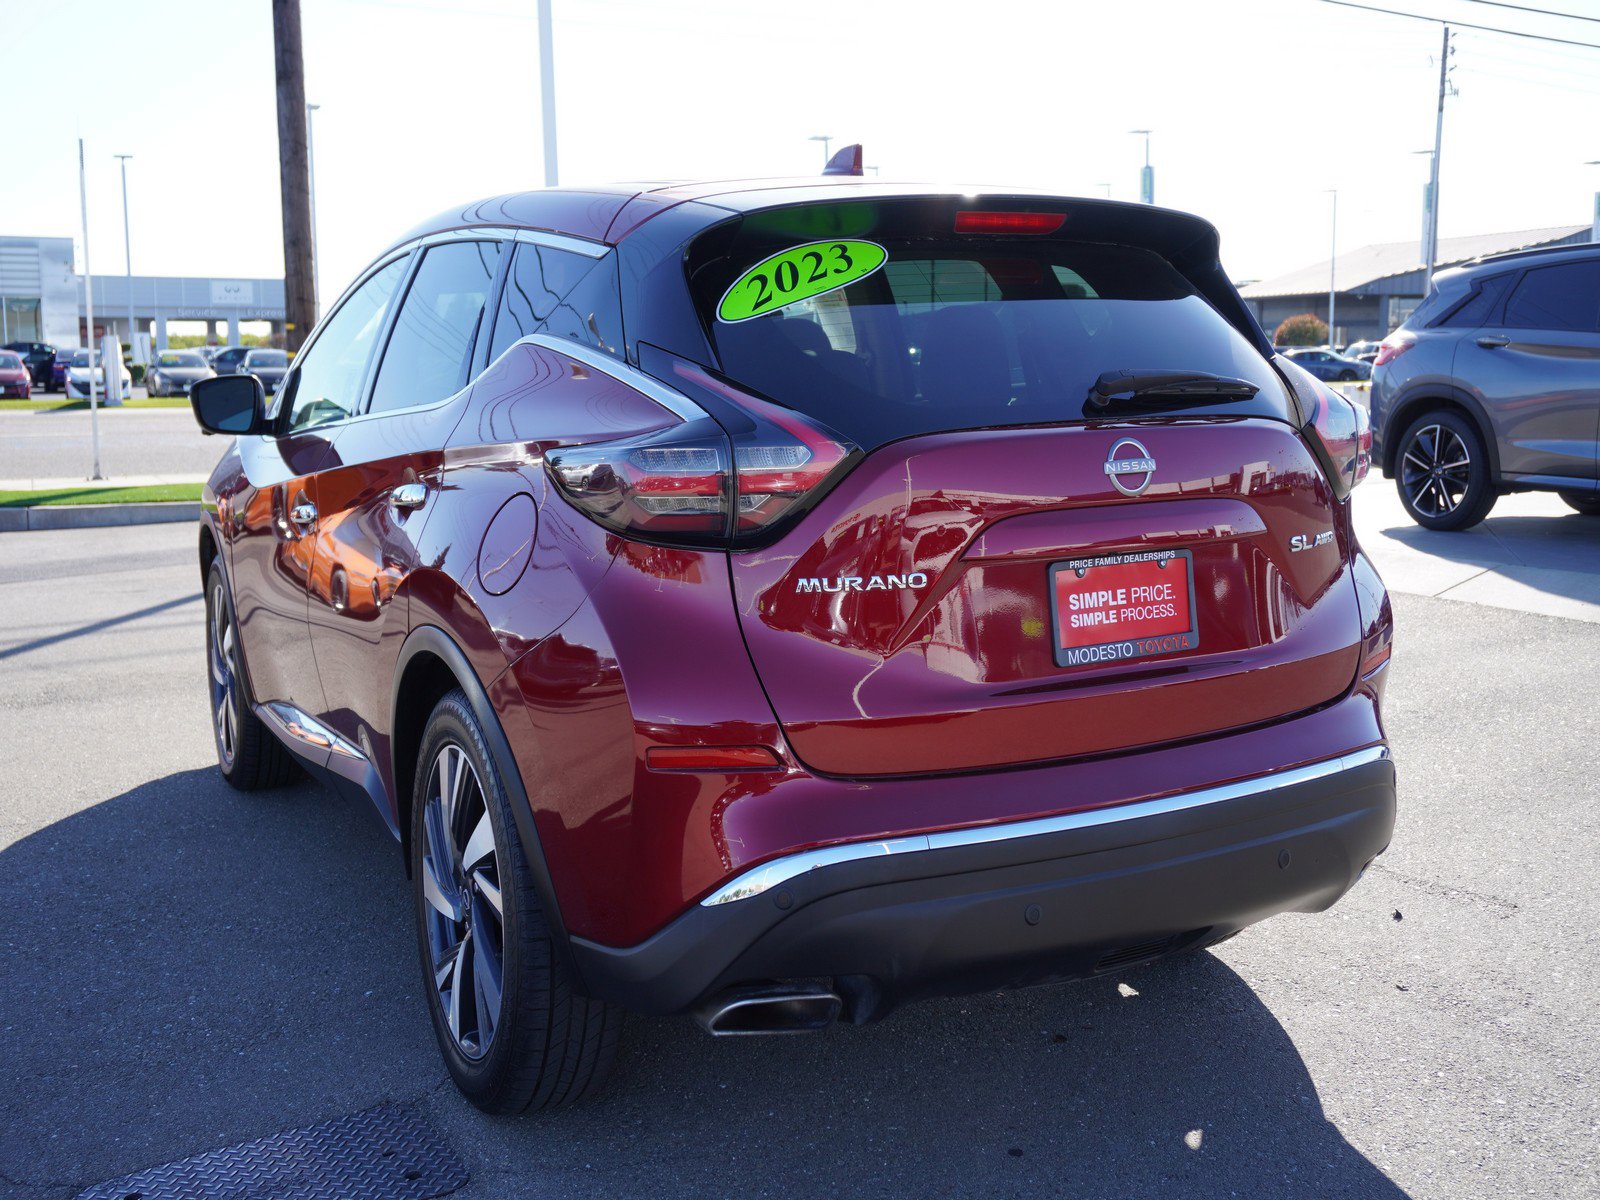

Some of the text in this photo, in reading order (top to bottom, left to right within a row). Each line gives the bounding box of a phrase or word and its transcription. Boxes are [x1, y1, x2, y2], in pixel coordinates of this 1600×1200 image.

[746, 243, 853, 312] 2023
[1105, 460, 1156, 472] NISSAN
[1289, 534, 1313, 553] SL
[1069, 550, 1176, 569] PRICE FAMILY DEALERSHIPS
[795, 572, 927, 593] MURANO
[1068, 583, 1176, 611] SIMPLE PRICE.
[1070, 603, 1178, 628] SIMPLE PROCESS.
[1068, 635, 1189, 665] MODESTO TOYOTA
